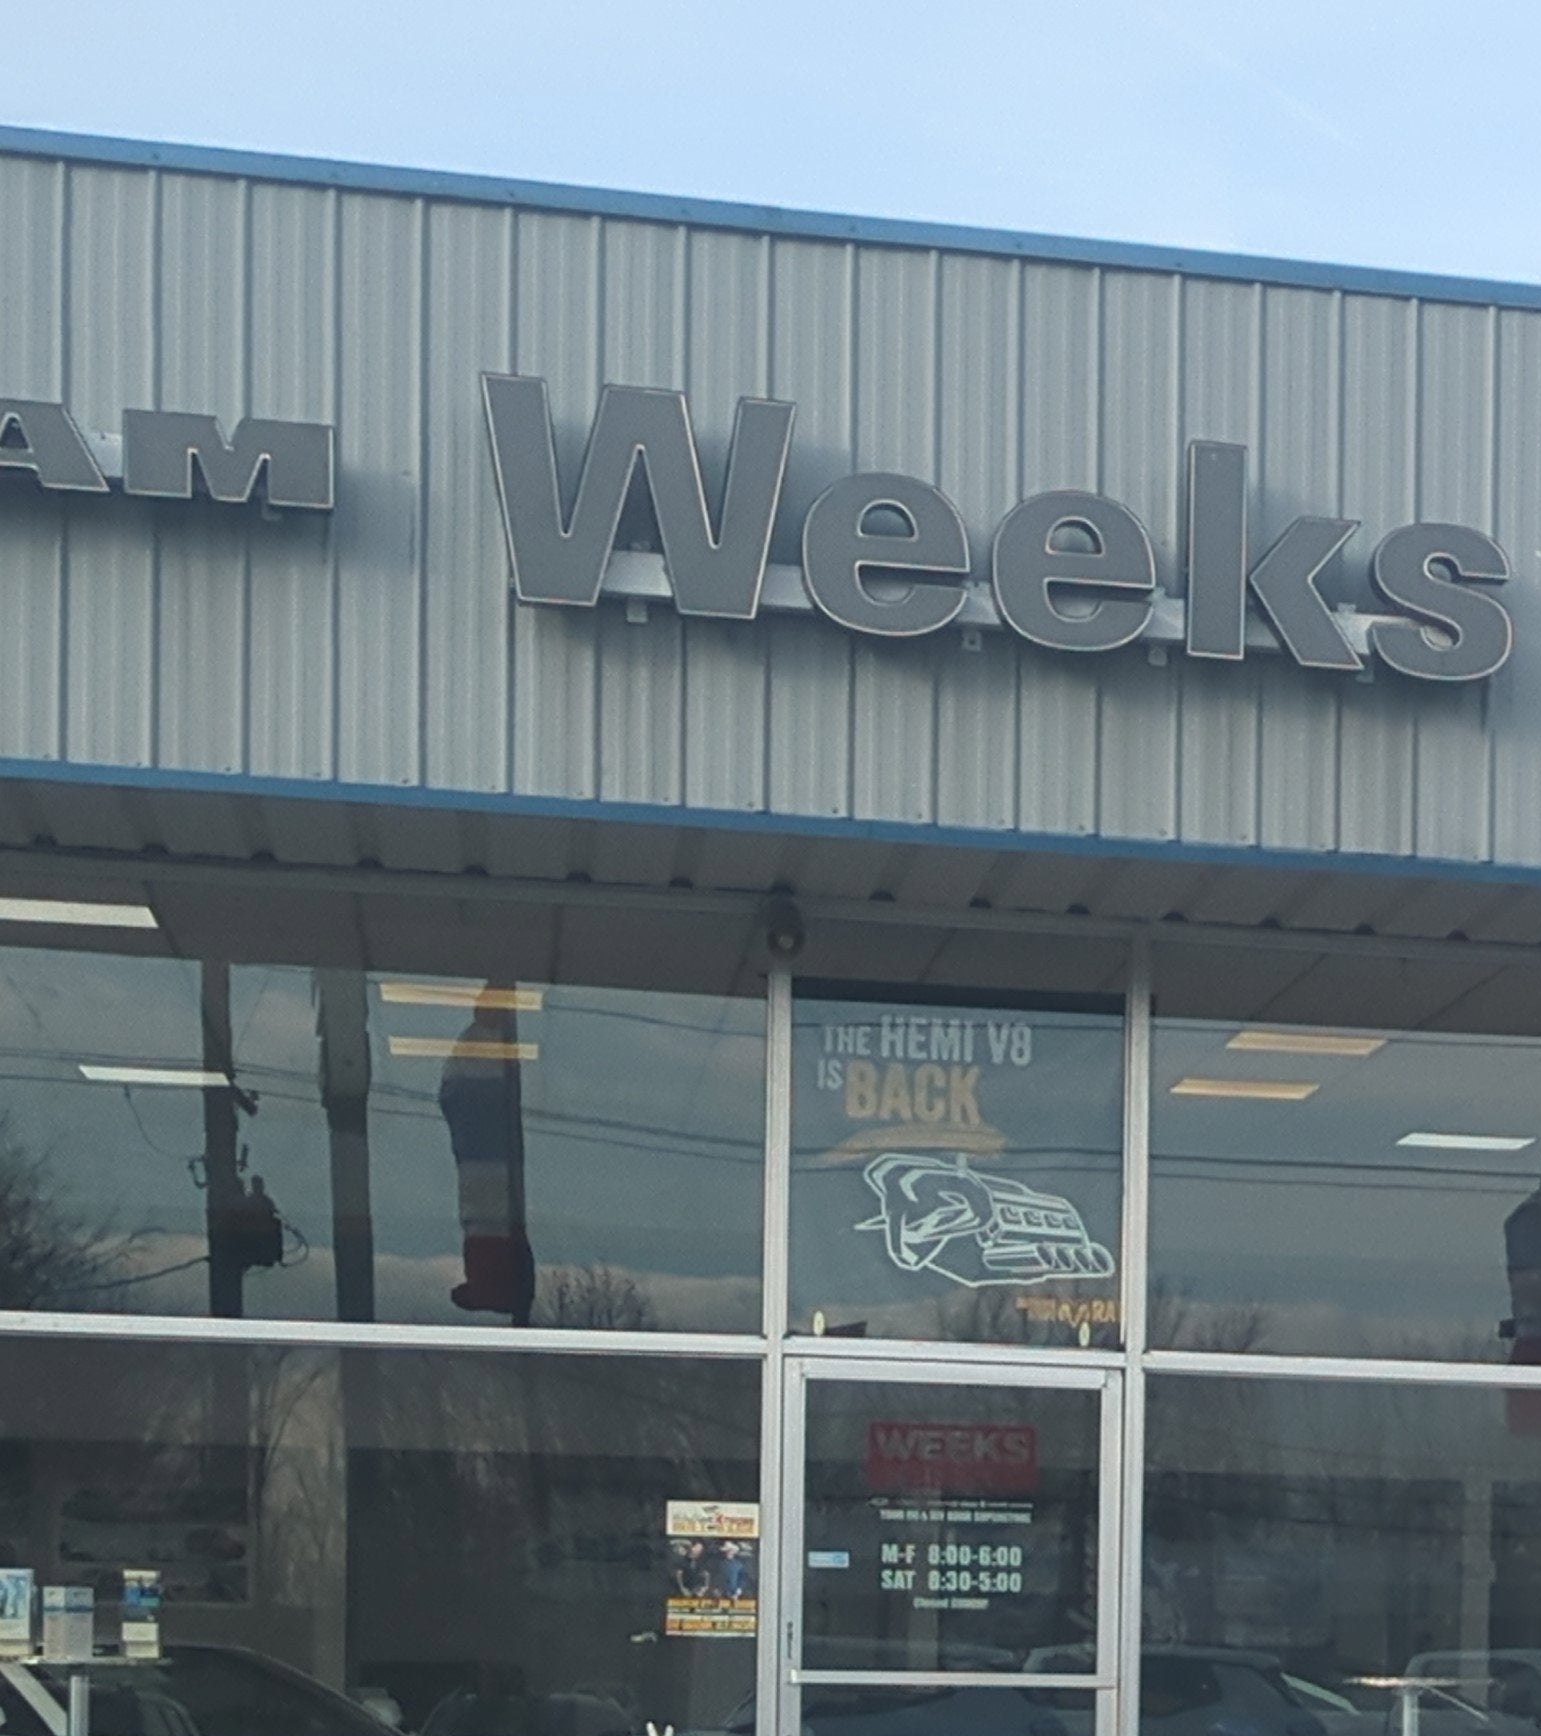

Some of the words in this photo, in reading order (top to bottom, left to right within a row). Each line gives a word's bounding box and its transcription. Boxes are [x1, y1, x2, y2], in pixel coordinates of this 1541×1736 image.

[481, 371, 1514, 681] Weeks
[822, 1024, 872, 1056] THE
[880, 1013, 974, 1063] HEMI
[987, 1020, 1033, 1067] V8
[816, 1058, 843, 1090] IS
[844, 1057, 982, 1126] BACK
[874, 1427, 1031, 1464] WEEKS
[880, 1543, 917, 1564] M-F
[880, 1569, 917, 1590] SAT
